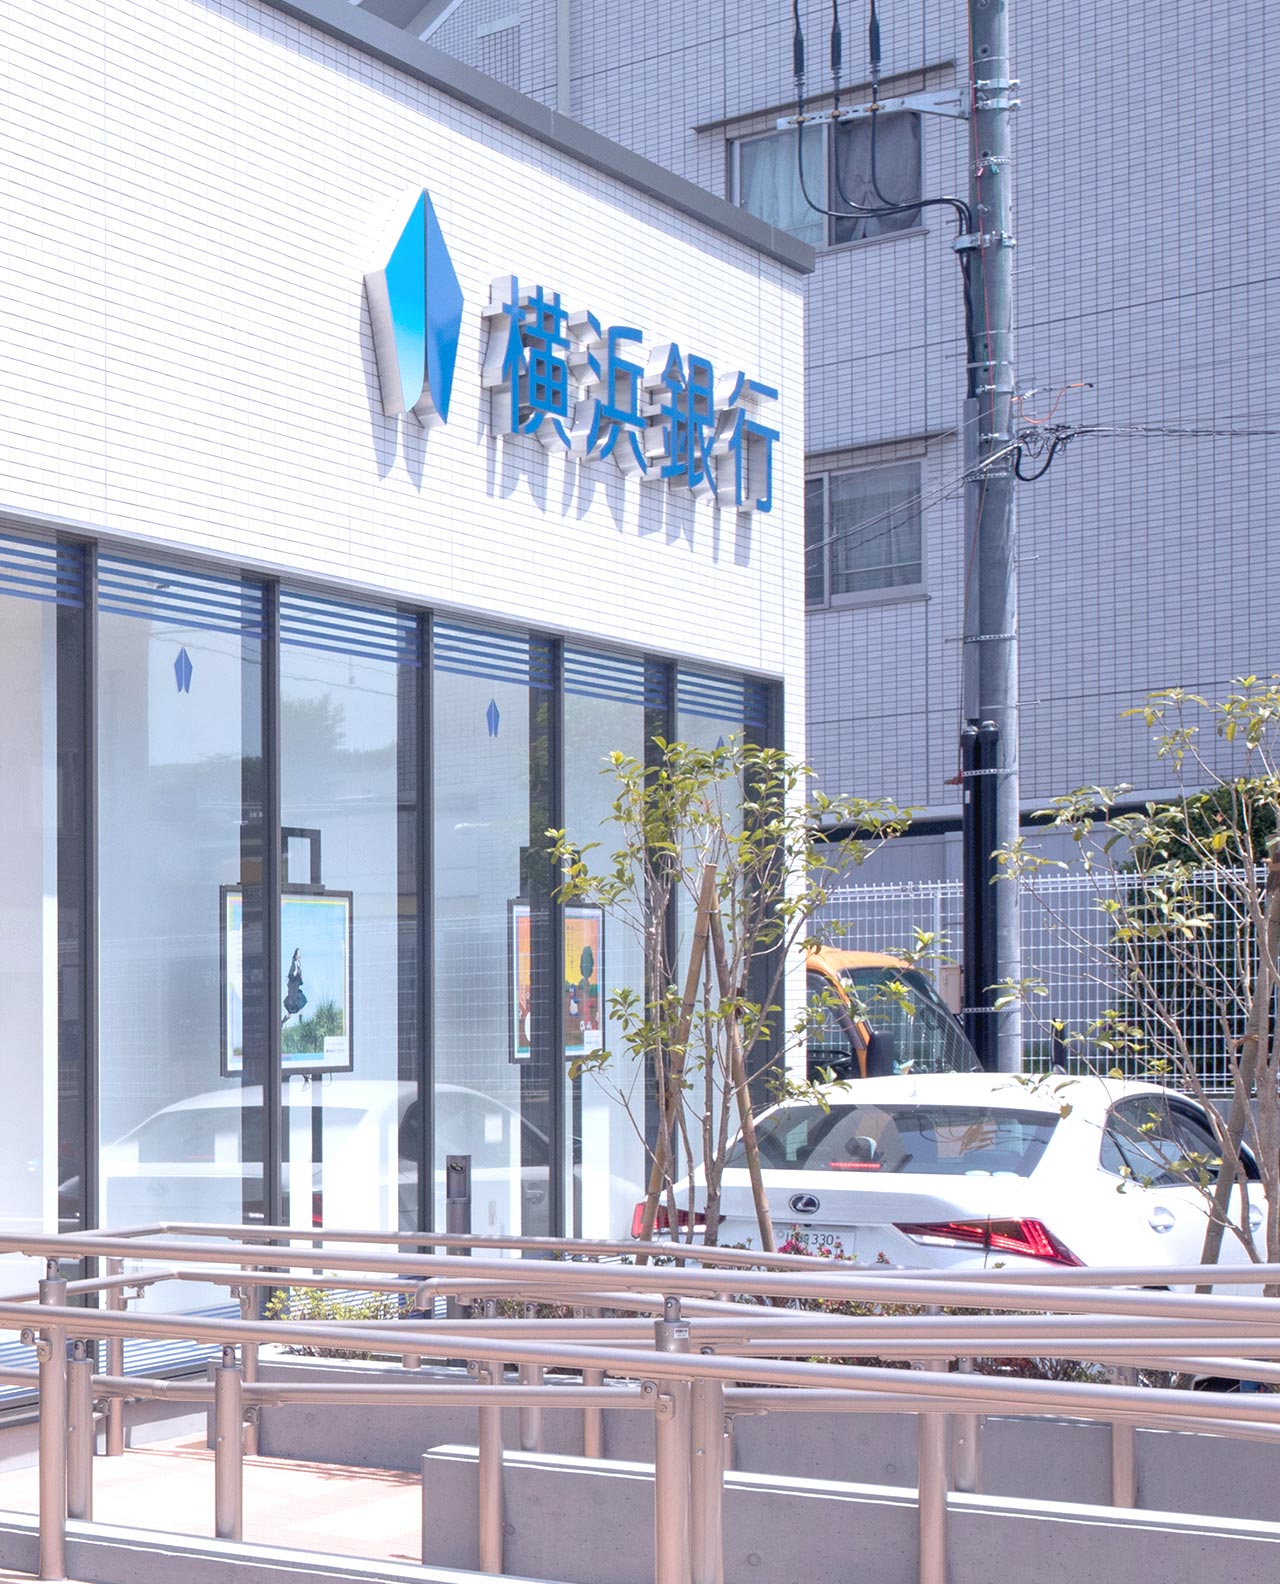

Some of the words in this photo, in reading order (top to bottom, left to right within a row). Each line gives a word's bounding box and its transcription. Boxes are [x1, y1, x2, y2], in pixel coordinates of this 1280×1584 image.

[485, 275, 780, 513] 横浜銀行
[810, 1233, 835, 1246] 330
